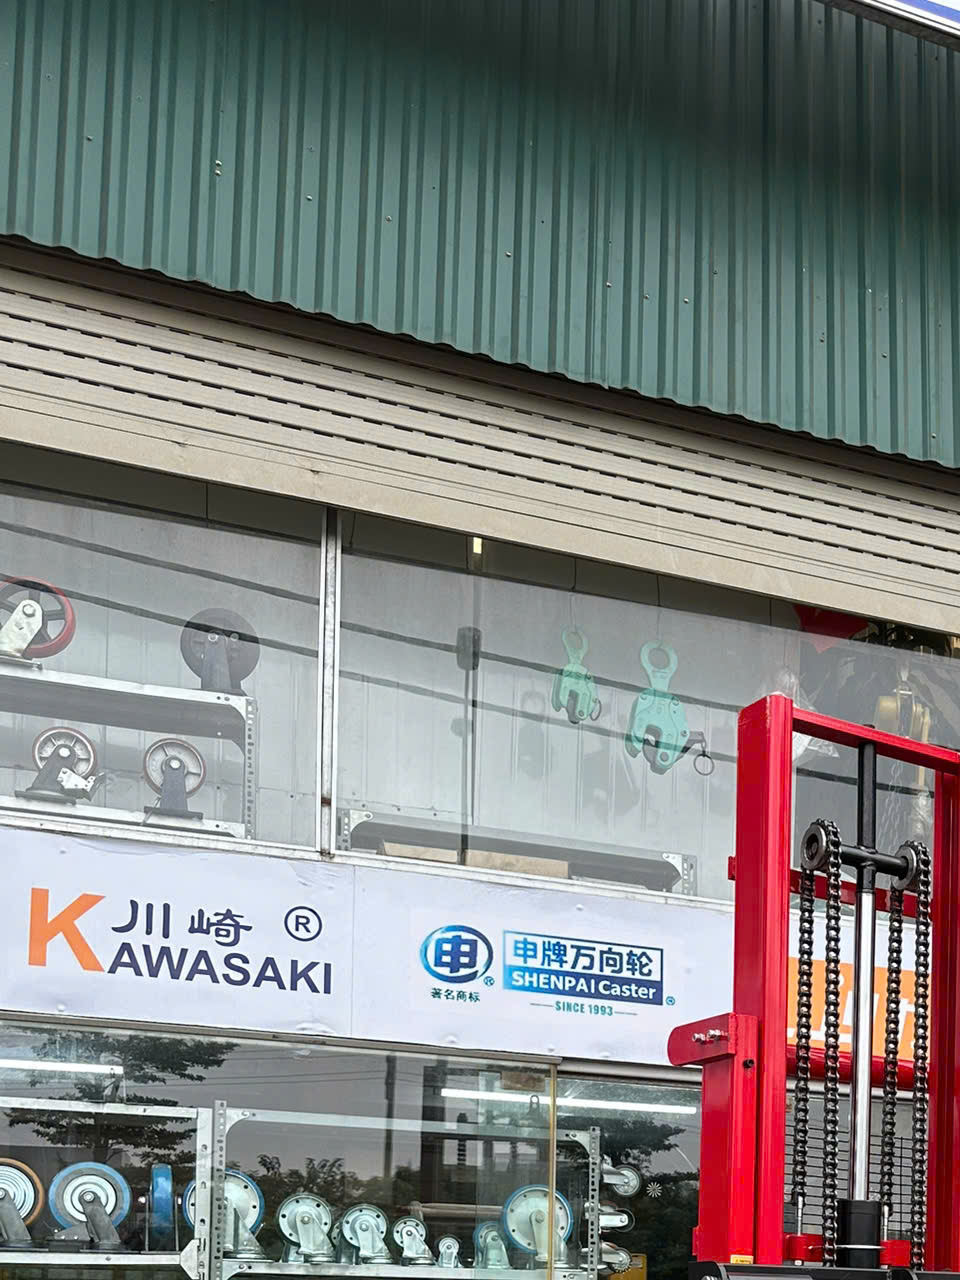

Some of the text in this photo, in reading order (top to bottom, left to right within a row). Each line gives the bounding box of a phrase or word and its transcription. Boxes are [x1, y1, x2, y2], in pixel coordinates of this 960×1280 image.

[28, 887, 332, 995] KAWASAKI
[111, 899, 253, 947] 川崎
[513, 937, 654, 977] 申牌万向轮
[511, 970, 595, 994] SHENPAI
[598, 980, 656, 999] Caster
[555, 1000, 613, 1017] SINCE 1993
